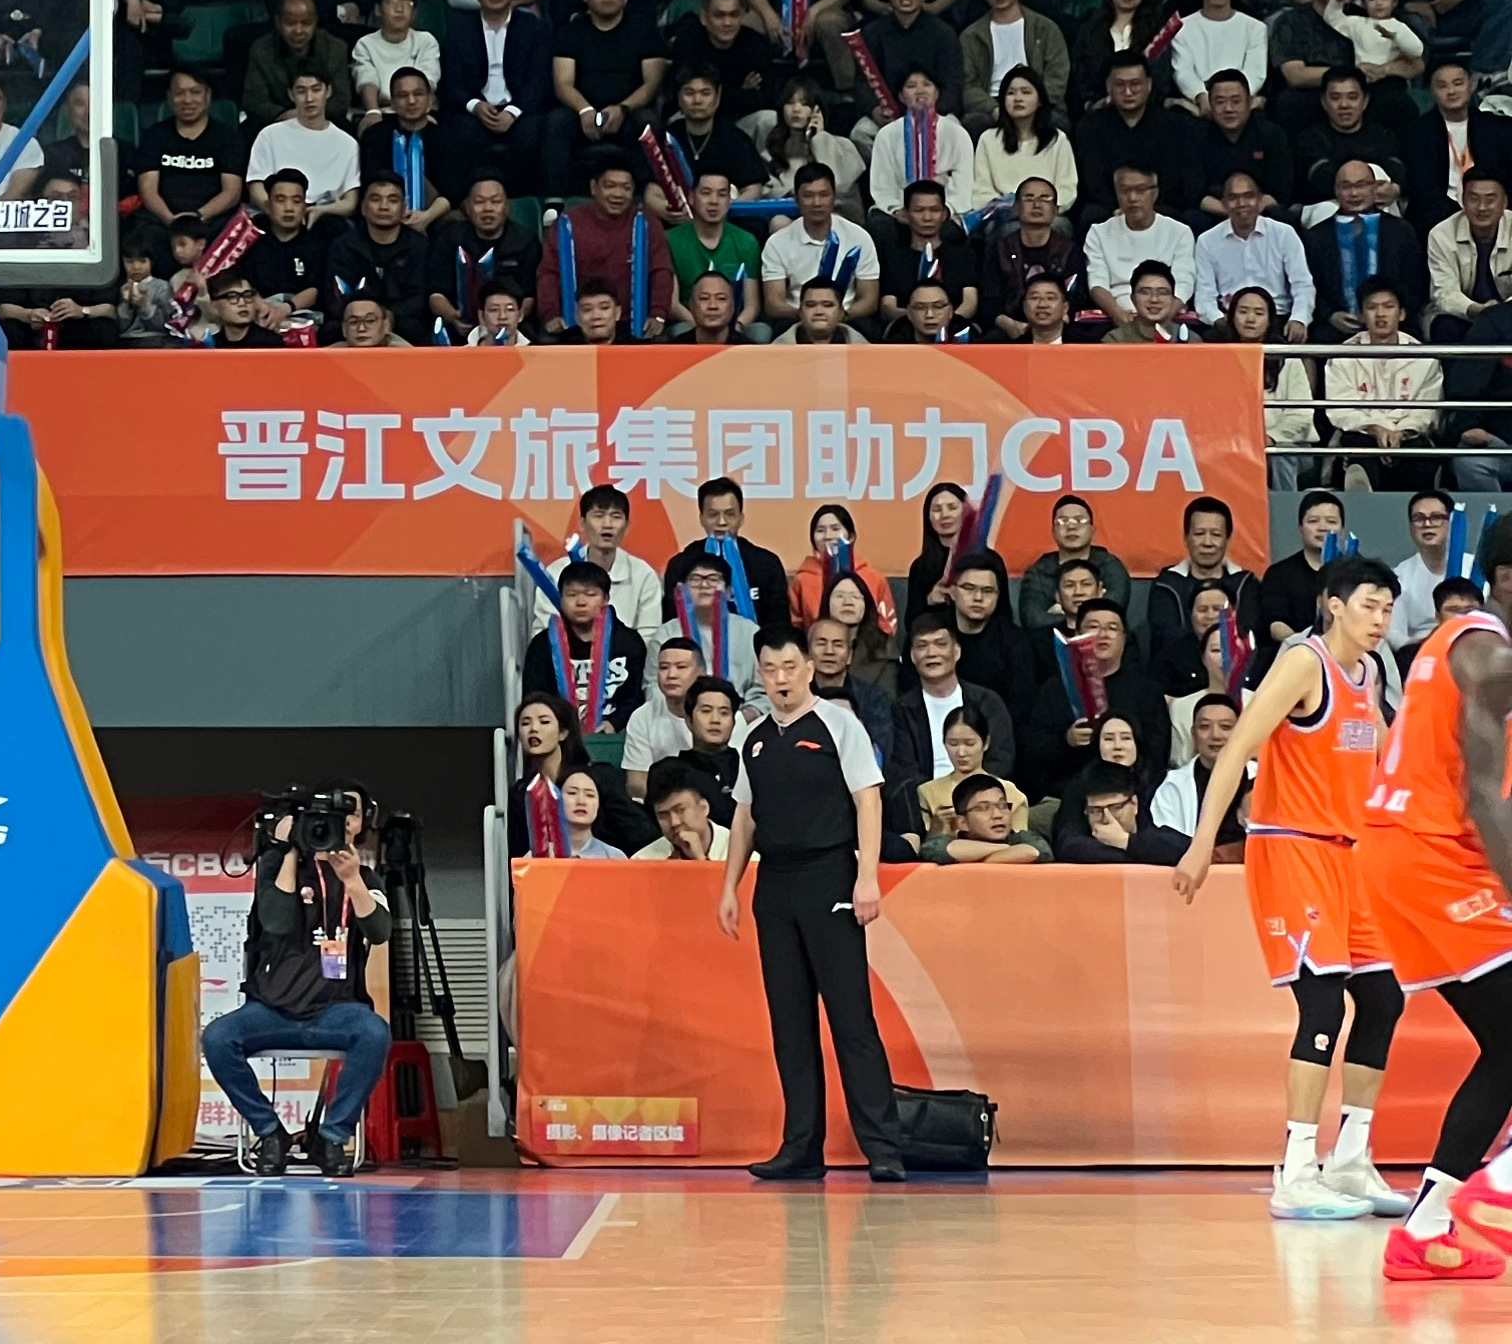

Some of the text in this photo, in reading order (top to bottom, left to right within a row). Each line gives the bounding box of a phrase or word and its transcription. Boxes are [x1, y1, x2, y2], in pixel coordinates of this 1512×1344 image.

[161, 154, 214, 169] adidas
[219, 406, 1203, 503] 晋江文旅集团助力CBA
